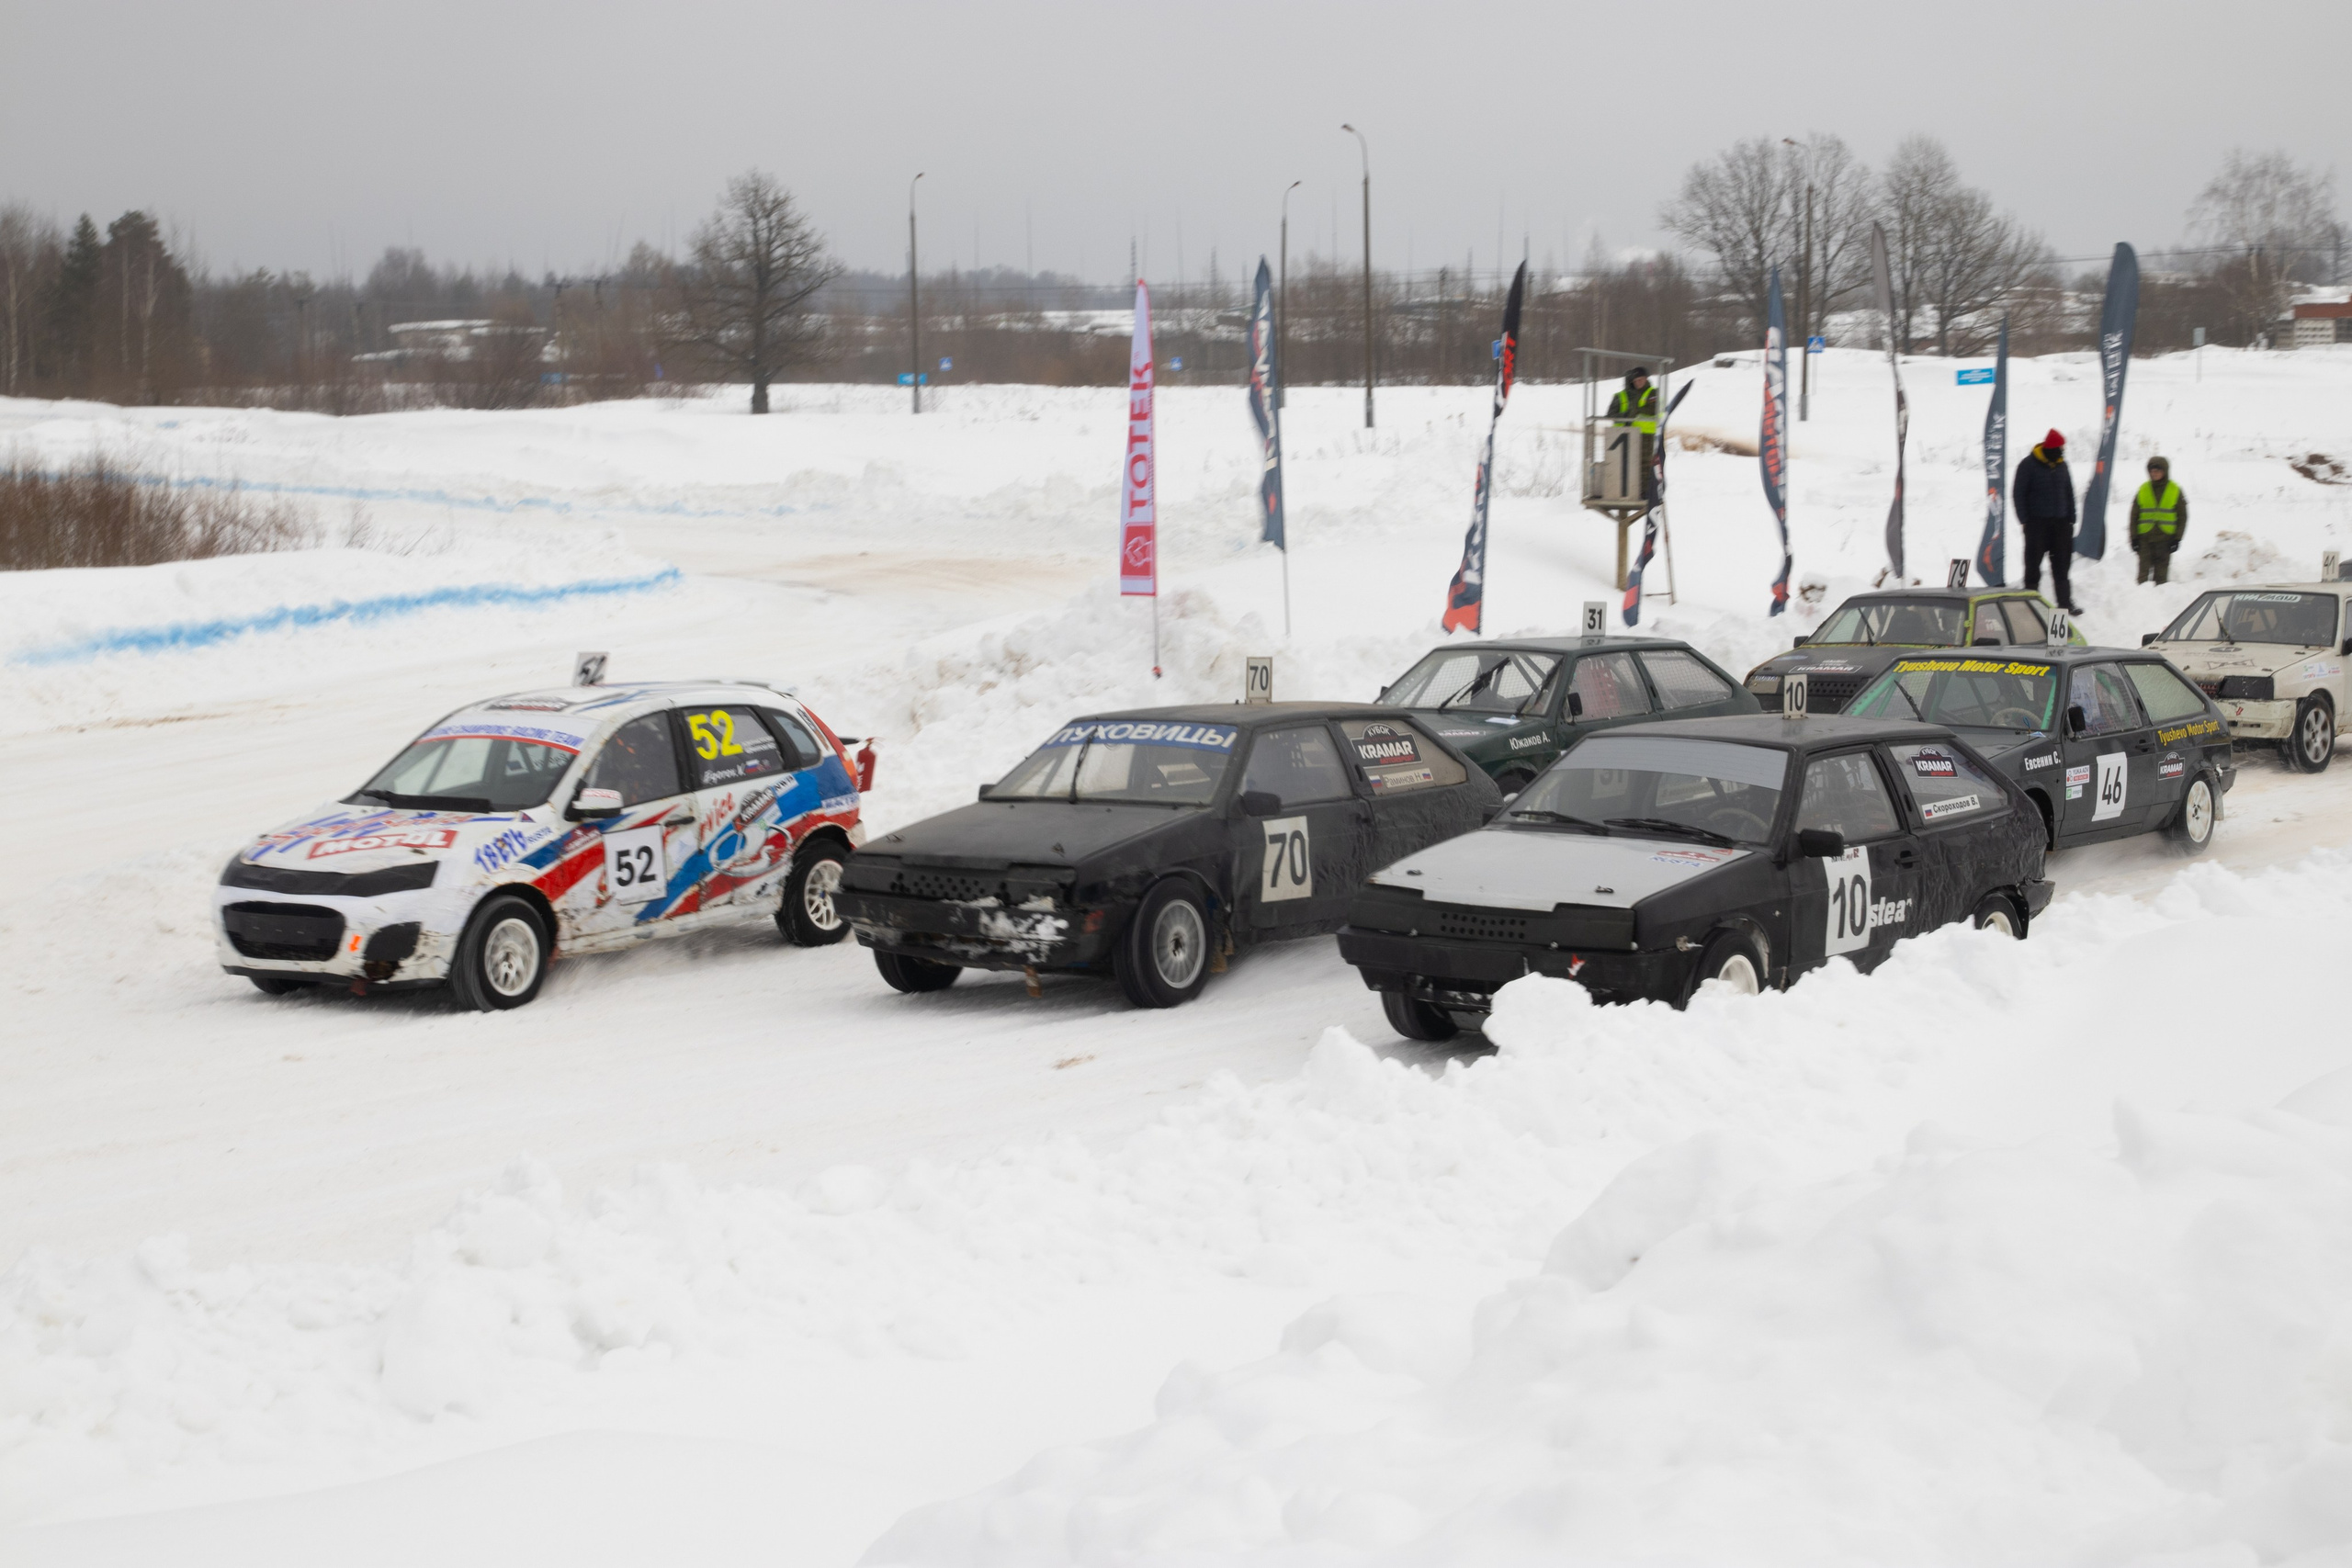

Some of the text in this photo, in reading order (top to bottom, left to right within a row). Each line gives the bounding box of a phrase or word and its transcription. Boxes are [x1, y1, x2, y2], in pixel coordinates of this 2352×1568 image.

[1607, 433, 1629, 499] 1
[1949, 559, 1968, 587] 79
[2323, 555, 2335, 575] 41
[1587, 608, 1603, 630] 31
[2050, 614, 2066, 638] 46
[1249, 665, 1270, 691] 70
[1893, 660, 2050, 677] Tyushevo Motor Sport
[1785, 681, 1805, 711] 10
[688, 709, 743, 761] 52
[1046, 723, 1238, 749] ЛУХОВИЦЫ
[1367, 726, 1391, 738] КУБОК
[1509, 731, 1551, 751] Южаков А.
[2157, 719, 2220, 747] Tyushevo Motor Sport
[1358, 740, 1414, 760] KRAMAR
[2024, 750, 2061, 771] Евсенин С.
[1916, 760, 1953, 772] KRAMAR
[2159, 762, 2183, 775] KRAMAR
[2101, 766, 2122, 805] 46
[1932, 796, 1979, 814] Скороходов В.
[315, 829, 447, 855] MOTUL
[616, 845, 657, 886] 52
[1268, 829, 1307, 888] 70
[1832, 874, 1867, 939] 10
[1869, 897, 1913, 928] stea
